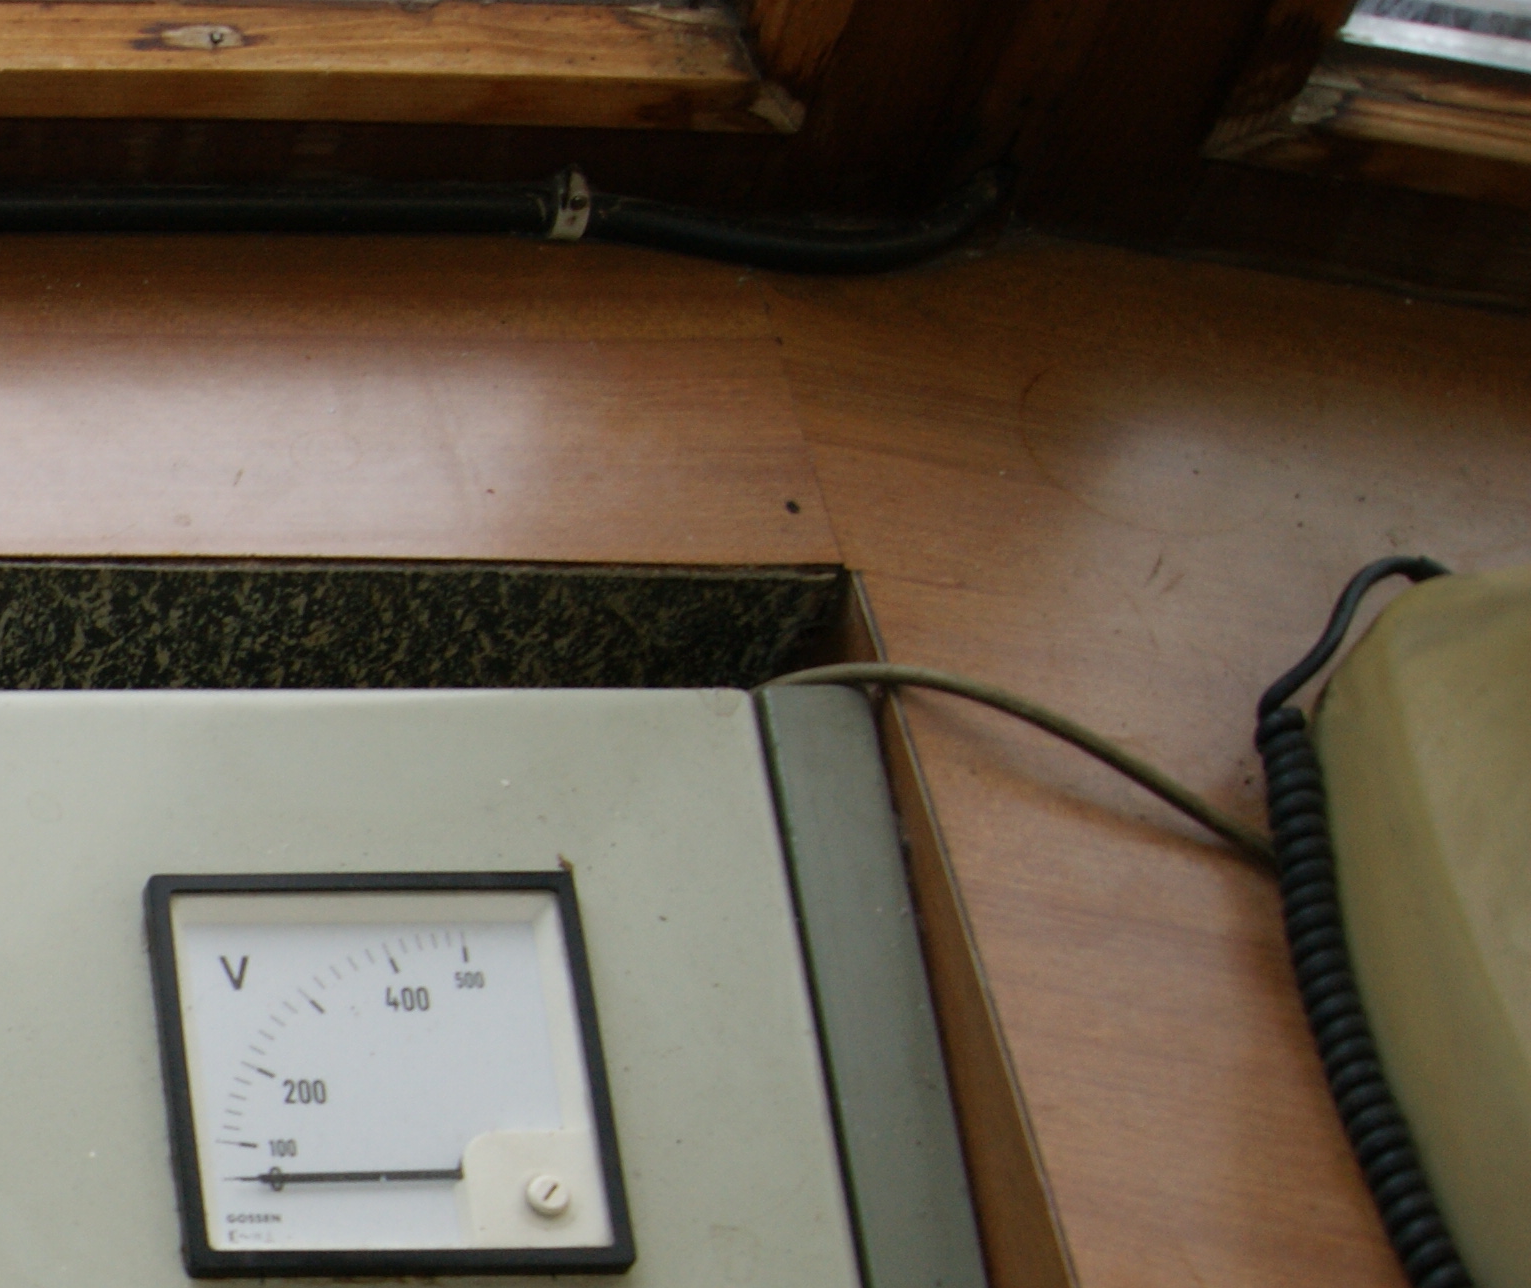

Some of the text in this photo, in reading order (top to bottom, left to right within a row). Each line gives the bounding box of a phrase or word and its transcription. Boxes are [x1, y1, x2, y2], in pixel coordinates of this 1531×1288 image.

[220, 955, 249, 990] V
[454, 971, 486, 990] 500
[386, 987, 430, 1012] 400
[283, 1079, 328, 1105] 200
[269, 1140, 297, 1158] 100
[226, 1213, 282, 1225] GOSSEN
